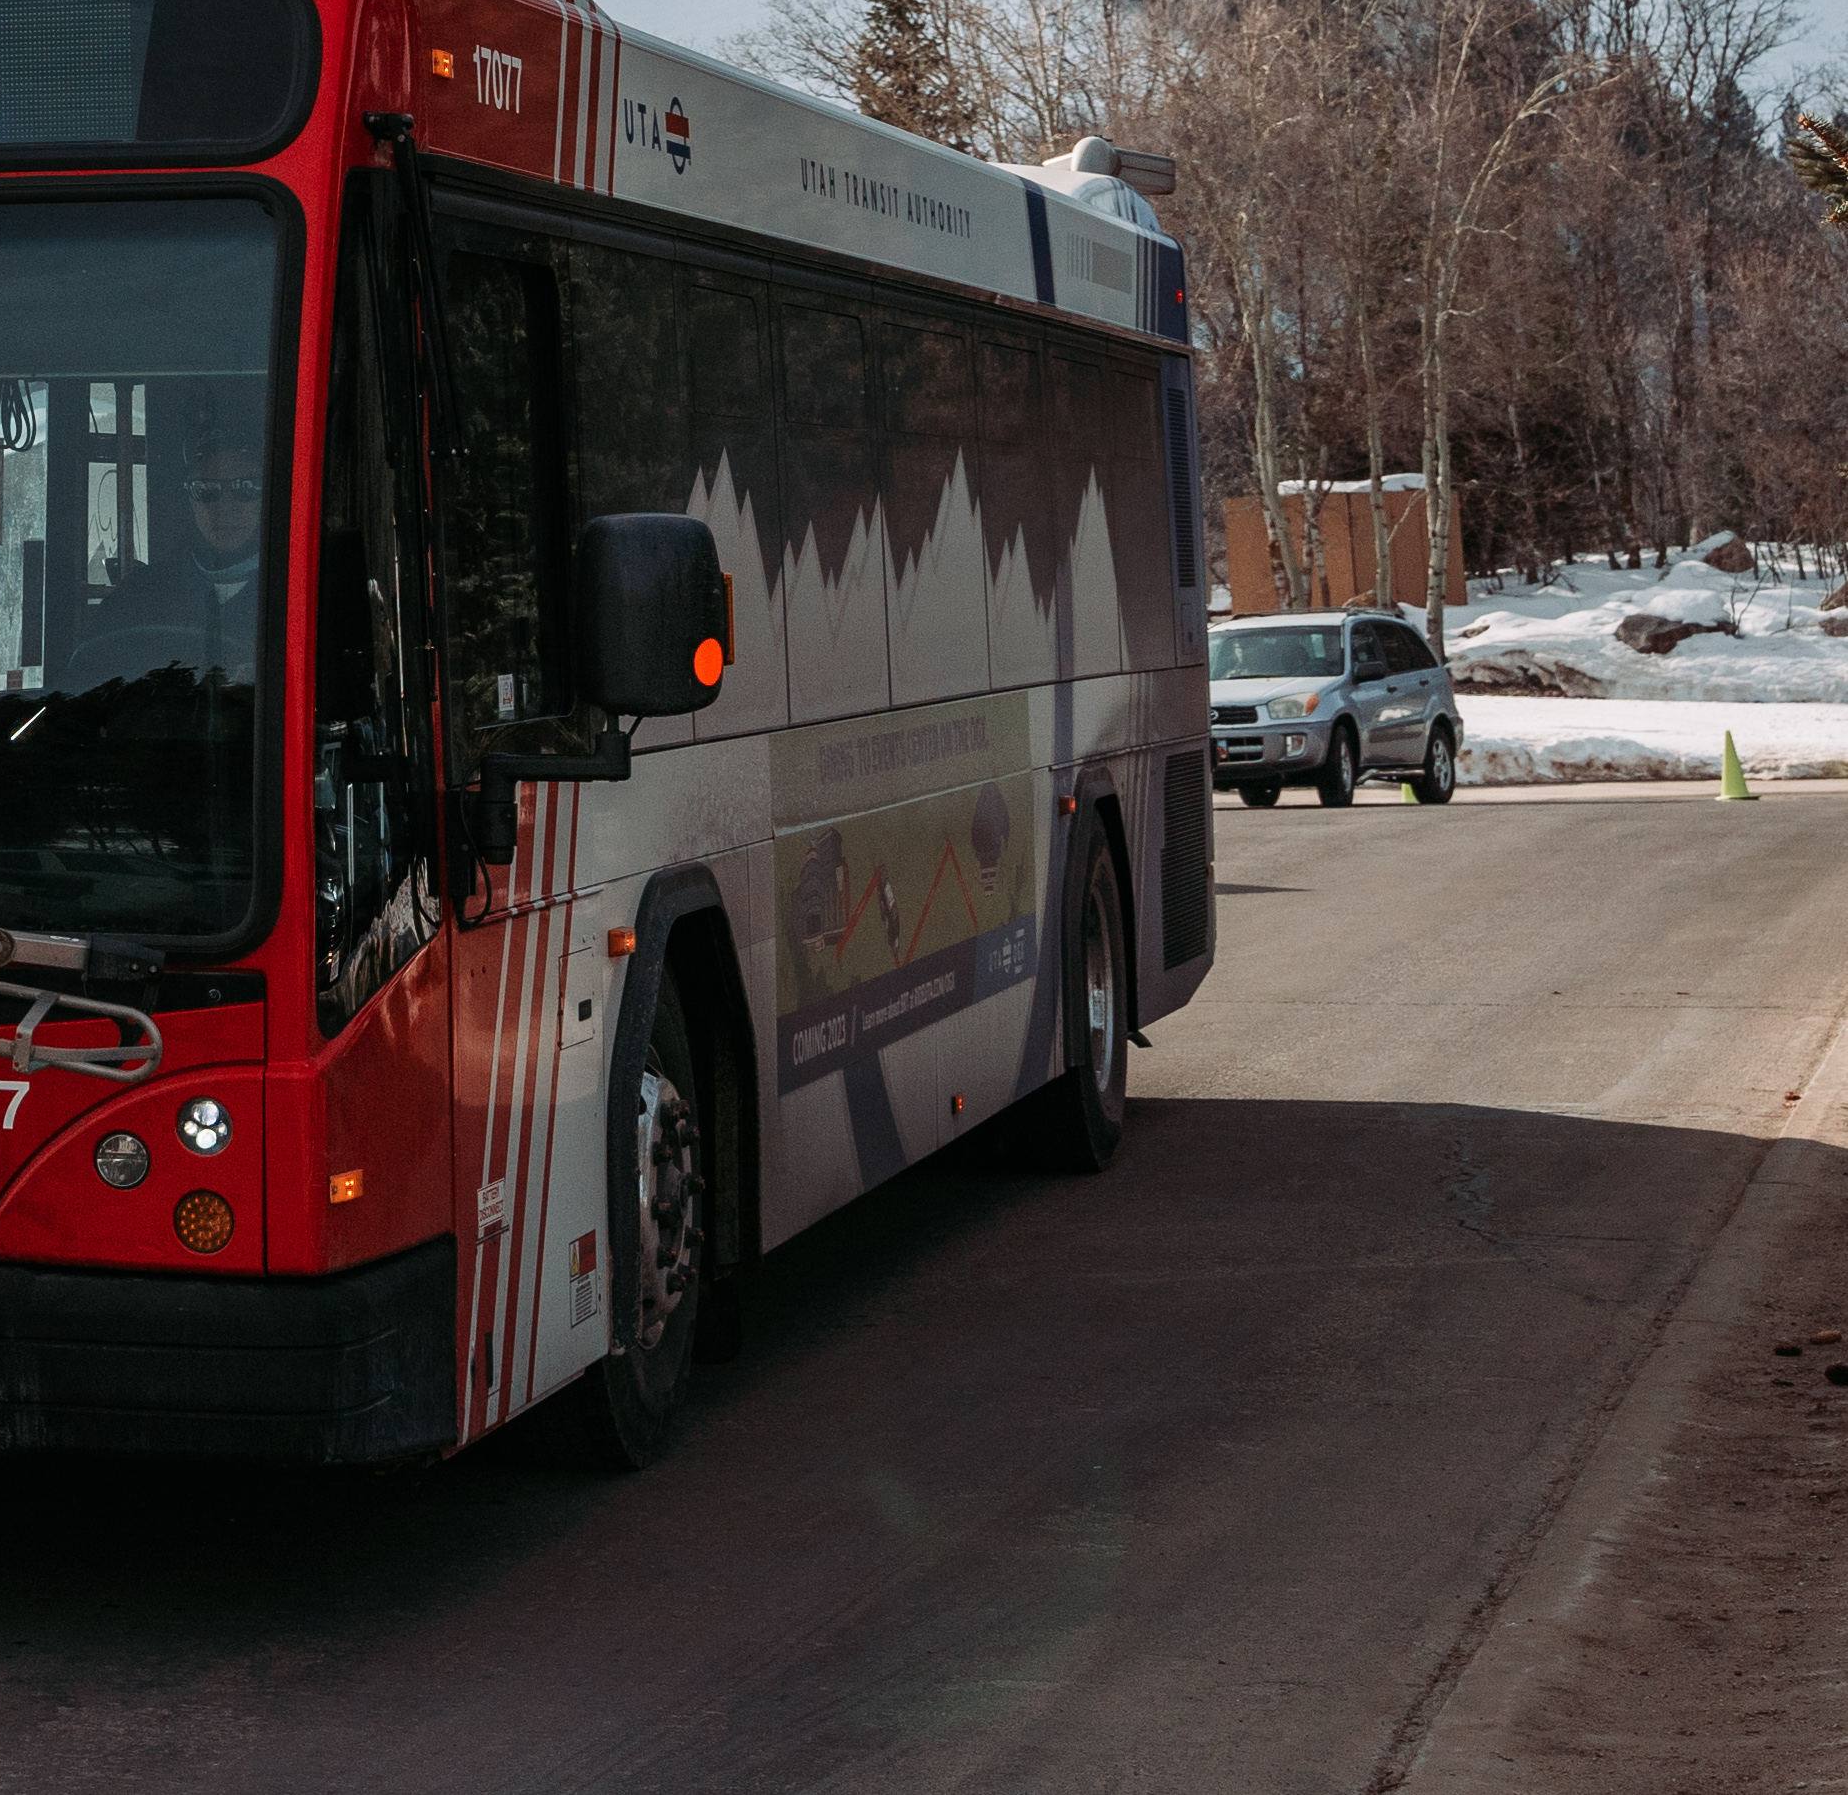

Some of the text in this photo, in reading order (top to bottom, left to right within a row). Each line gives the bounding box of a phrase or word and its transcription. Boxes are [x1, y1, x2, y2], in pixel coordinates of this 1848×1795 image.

[472, 44, 523, 114] 17077
[623, 98, 662, 152] UTA
[800, 157, 971, 239] UTAH TRANSIT AUTHORITY
[793, 1013, 847, 1066] COMING 2023
